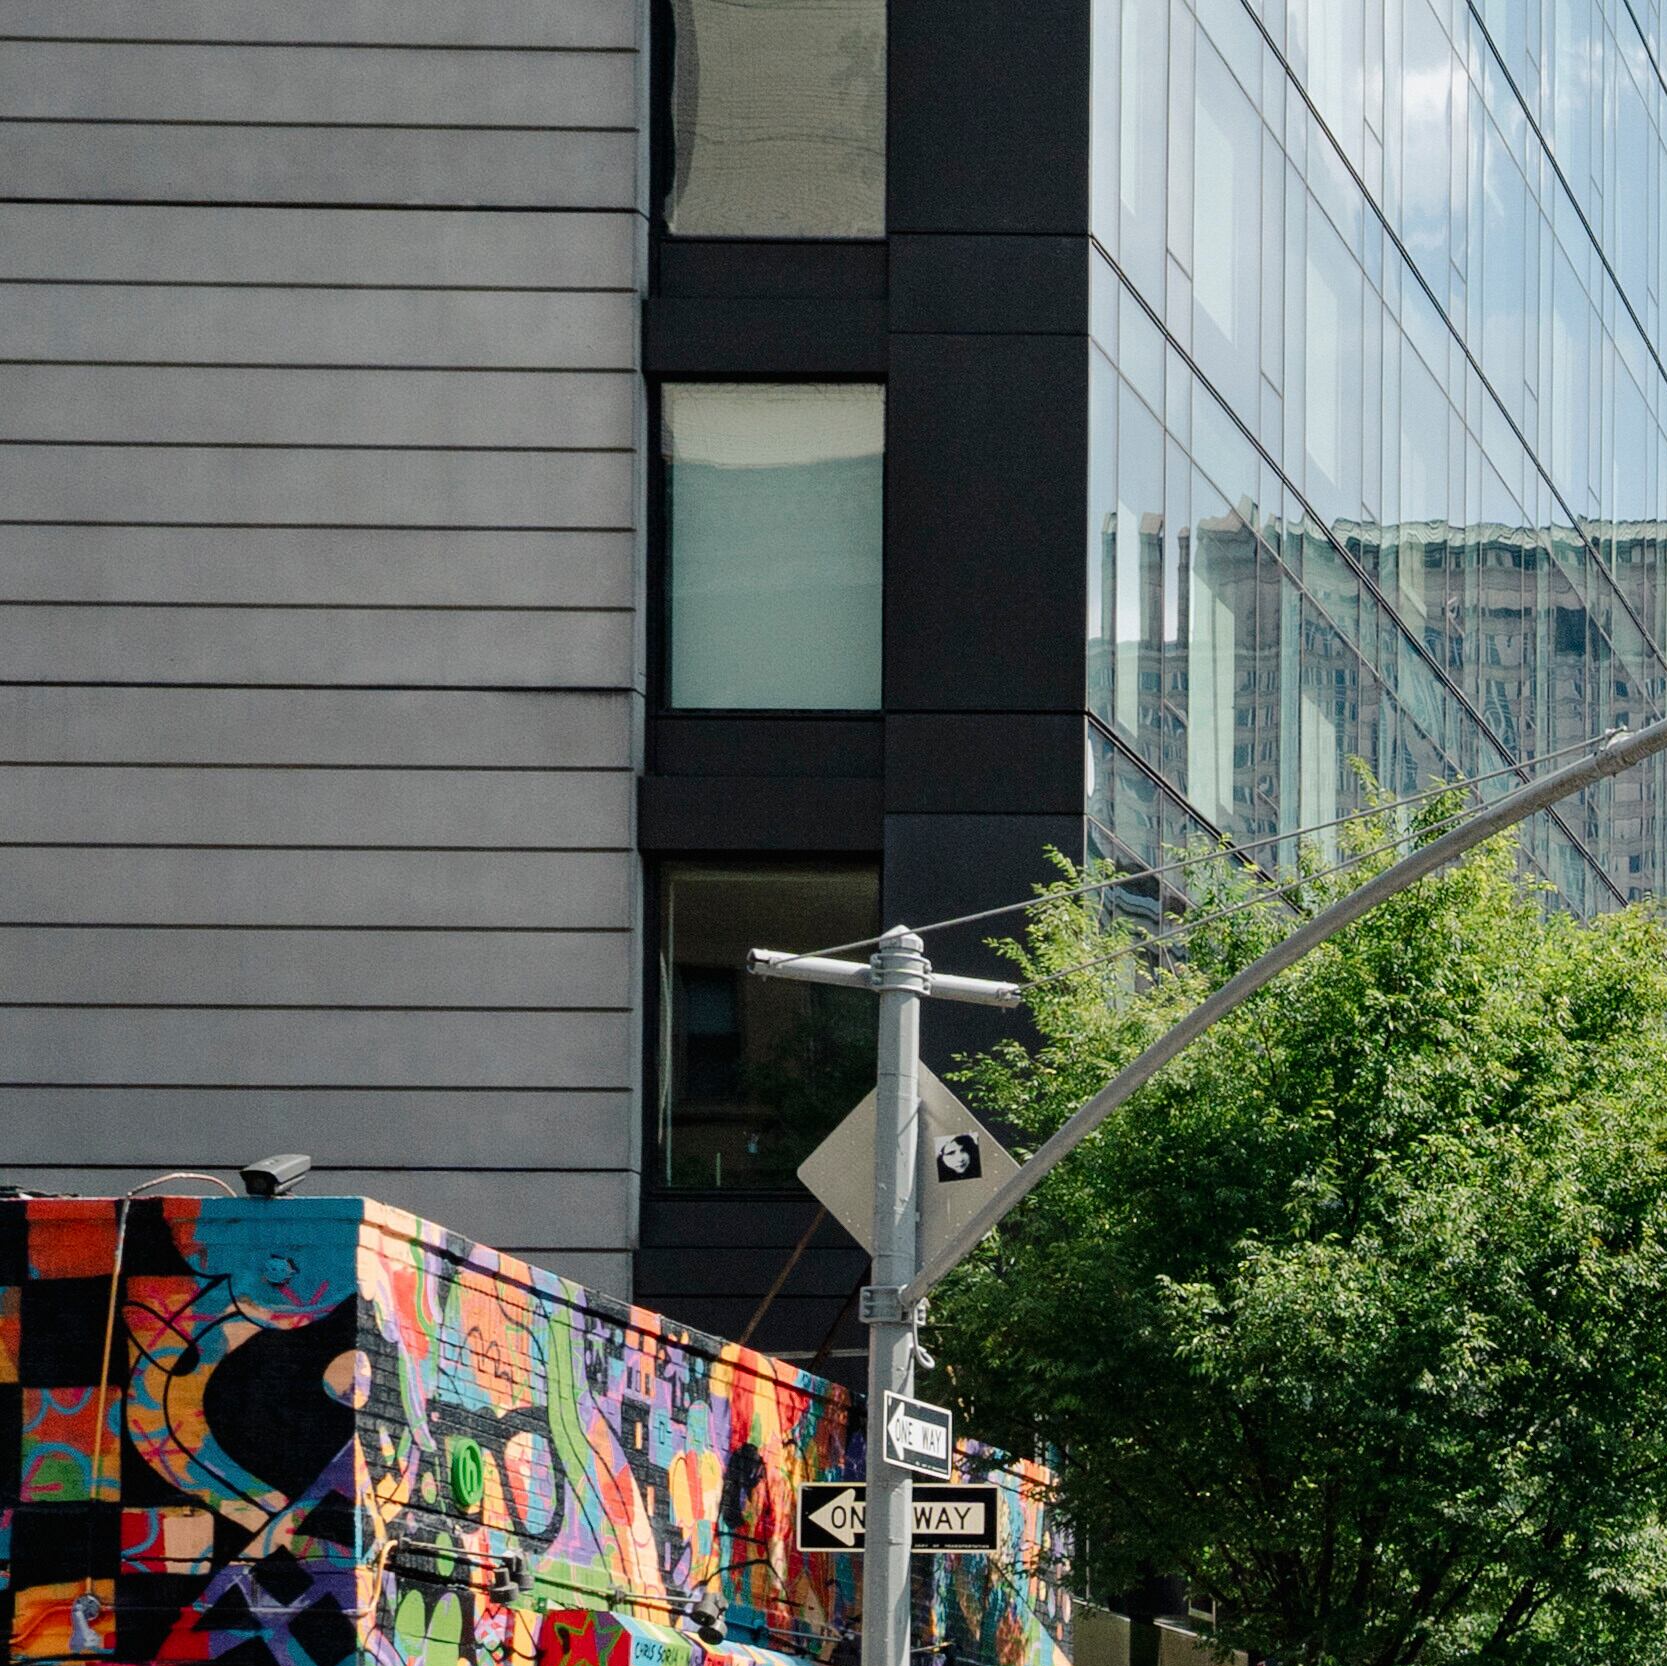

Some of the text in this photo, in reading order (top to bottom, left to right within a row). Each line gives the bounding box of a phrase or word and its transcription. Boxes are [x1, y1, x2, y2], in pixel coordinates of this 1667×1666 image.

[895, 1418, 942, 1455] ONE WAY
[831, 1505, 972, 1530] ON WAY
